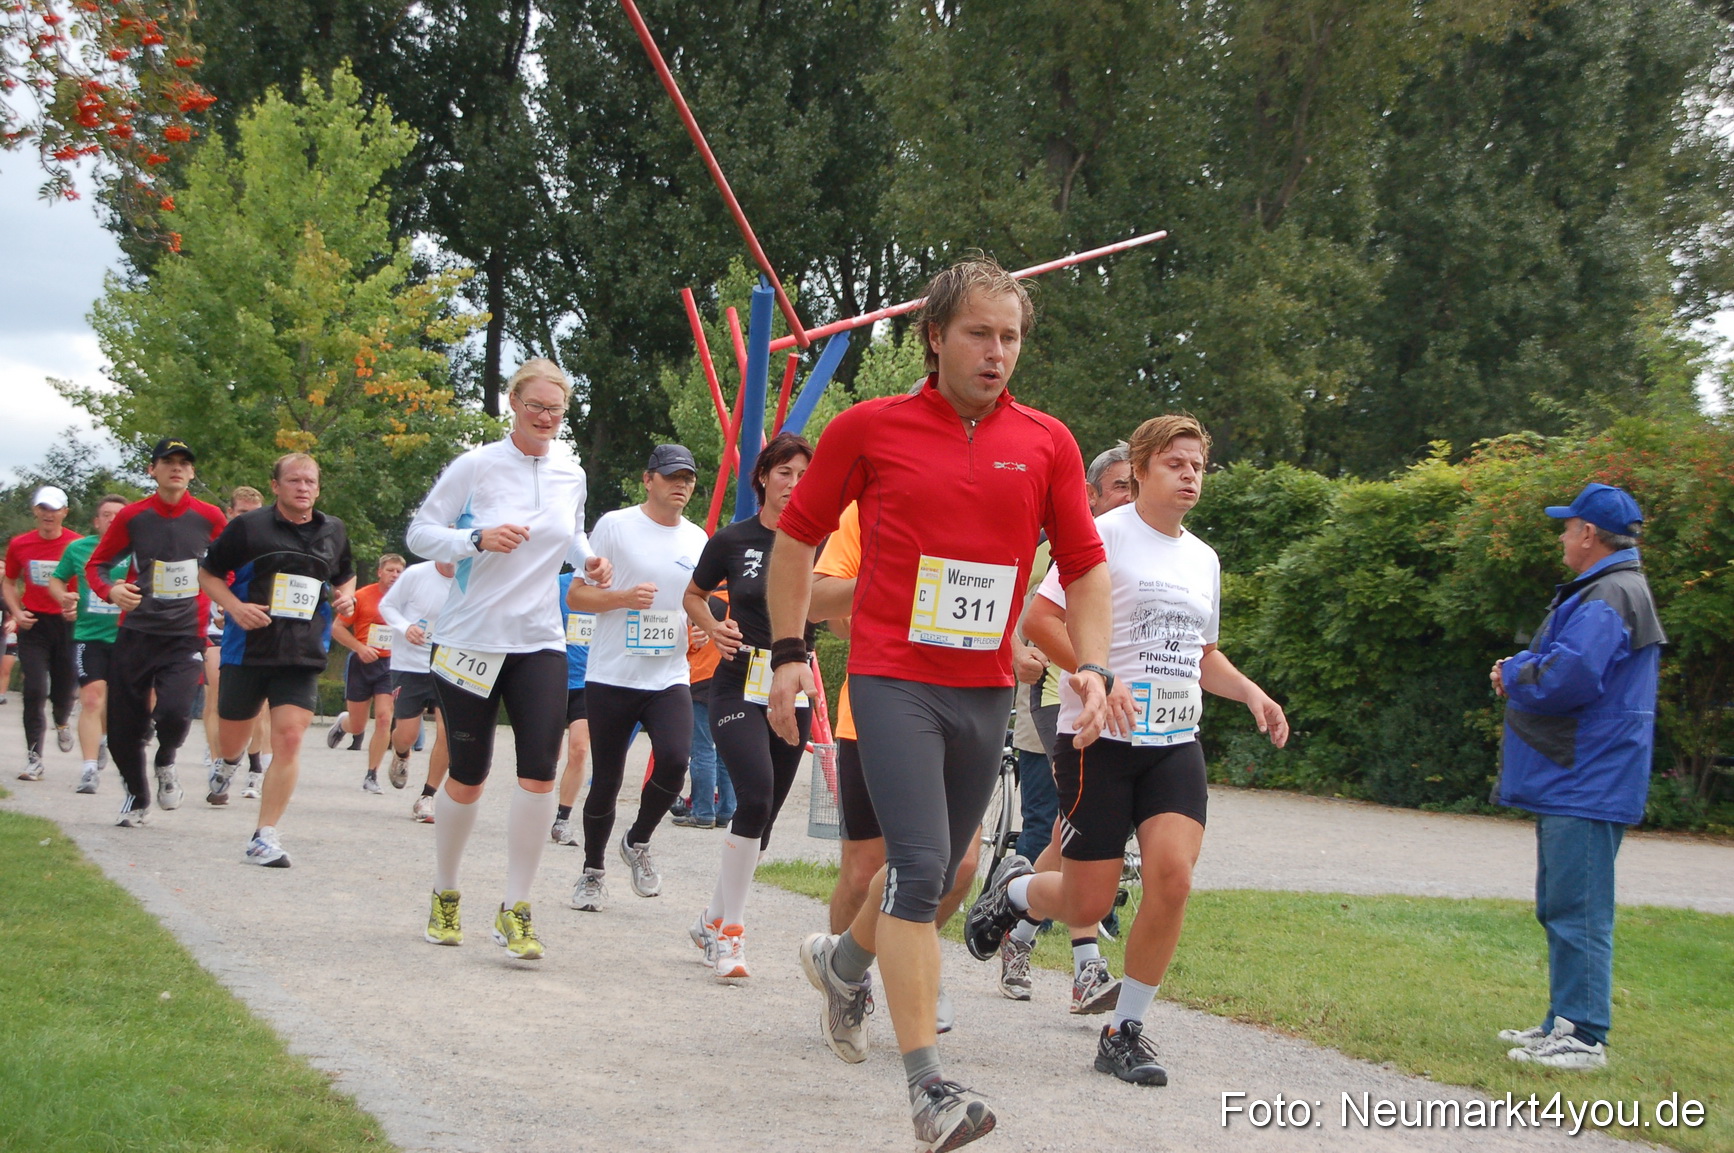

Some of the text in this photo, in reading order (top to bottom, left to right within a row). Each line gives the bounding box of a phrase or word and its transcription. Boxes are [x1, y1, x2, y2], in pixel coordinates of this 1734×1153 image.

[174, 575, 189, 587] 95
[289, 579, 308, 589] Klaus
[919, 567, 995, 602] C Werner
[1139, 580, 1155, 588] Post
[1155, 580, 1164, 588] SV
[292, 592, 316, 606] 397
[952, 596, 995, 622] 311
[643, 614, 669, 624] Wilfried
[379, 634, 392, 642] 897
[580, 627, 595, 636] 63
[643, 627, 674, 640] 2216
[1164, 639, 1181, 652] 10.
[456, 651, 488, 676] 710
[1139, 651, 1197, 668] FINISH LINE
[1156, 687, 1189, 700] Thomas
[718, 711, 745, 727] ODLO
[1154, 704, 1195, 724] 2141
